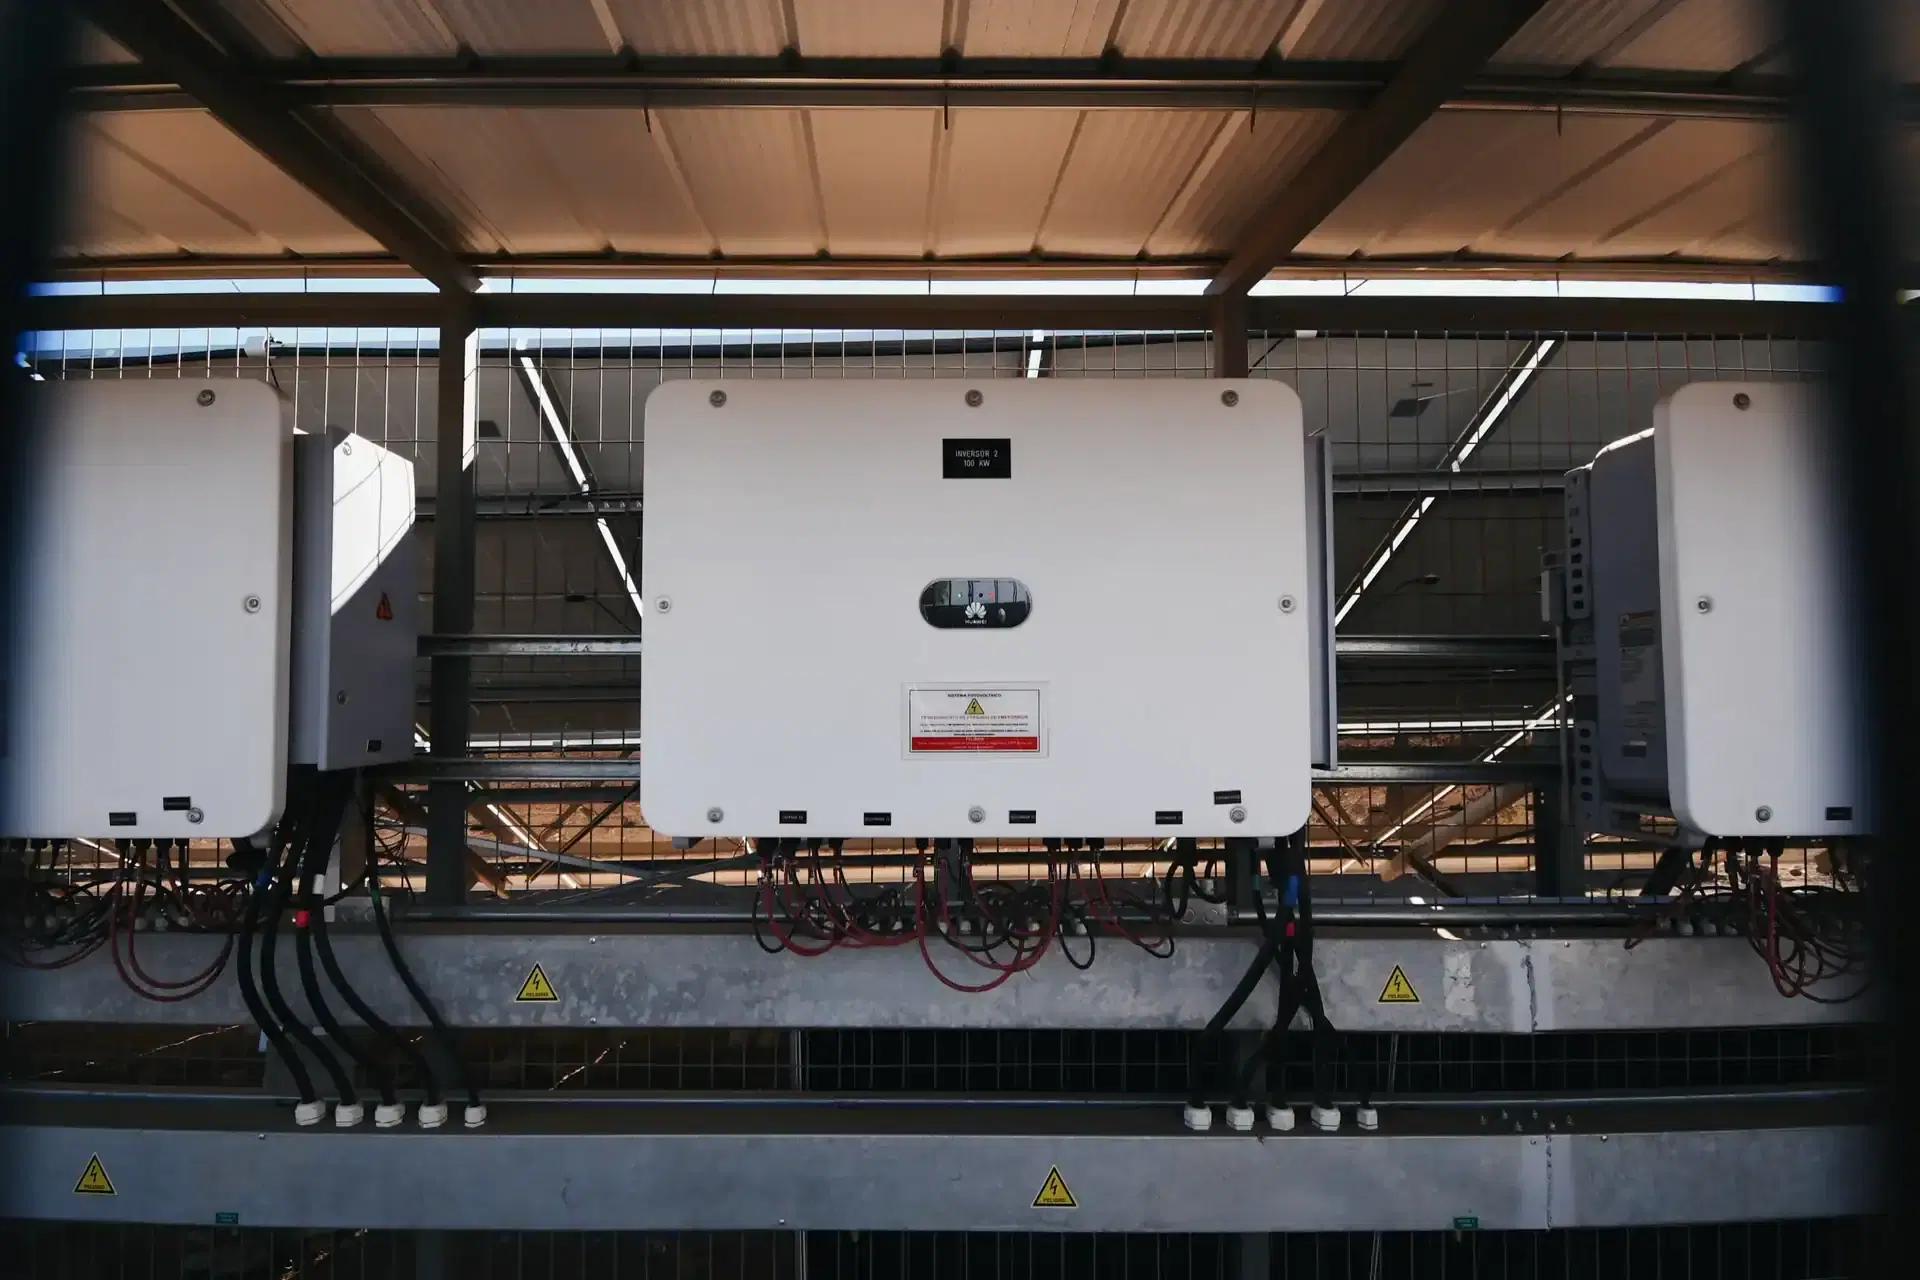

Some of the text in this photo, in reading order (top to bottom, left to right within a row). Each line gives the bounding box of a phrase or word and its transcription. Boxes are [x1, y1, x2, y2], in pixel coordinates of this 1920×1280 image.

[955, 450, 998, 458] INVERSOR 2
[963, 459, 990, 468] 100 KW
